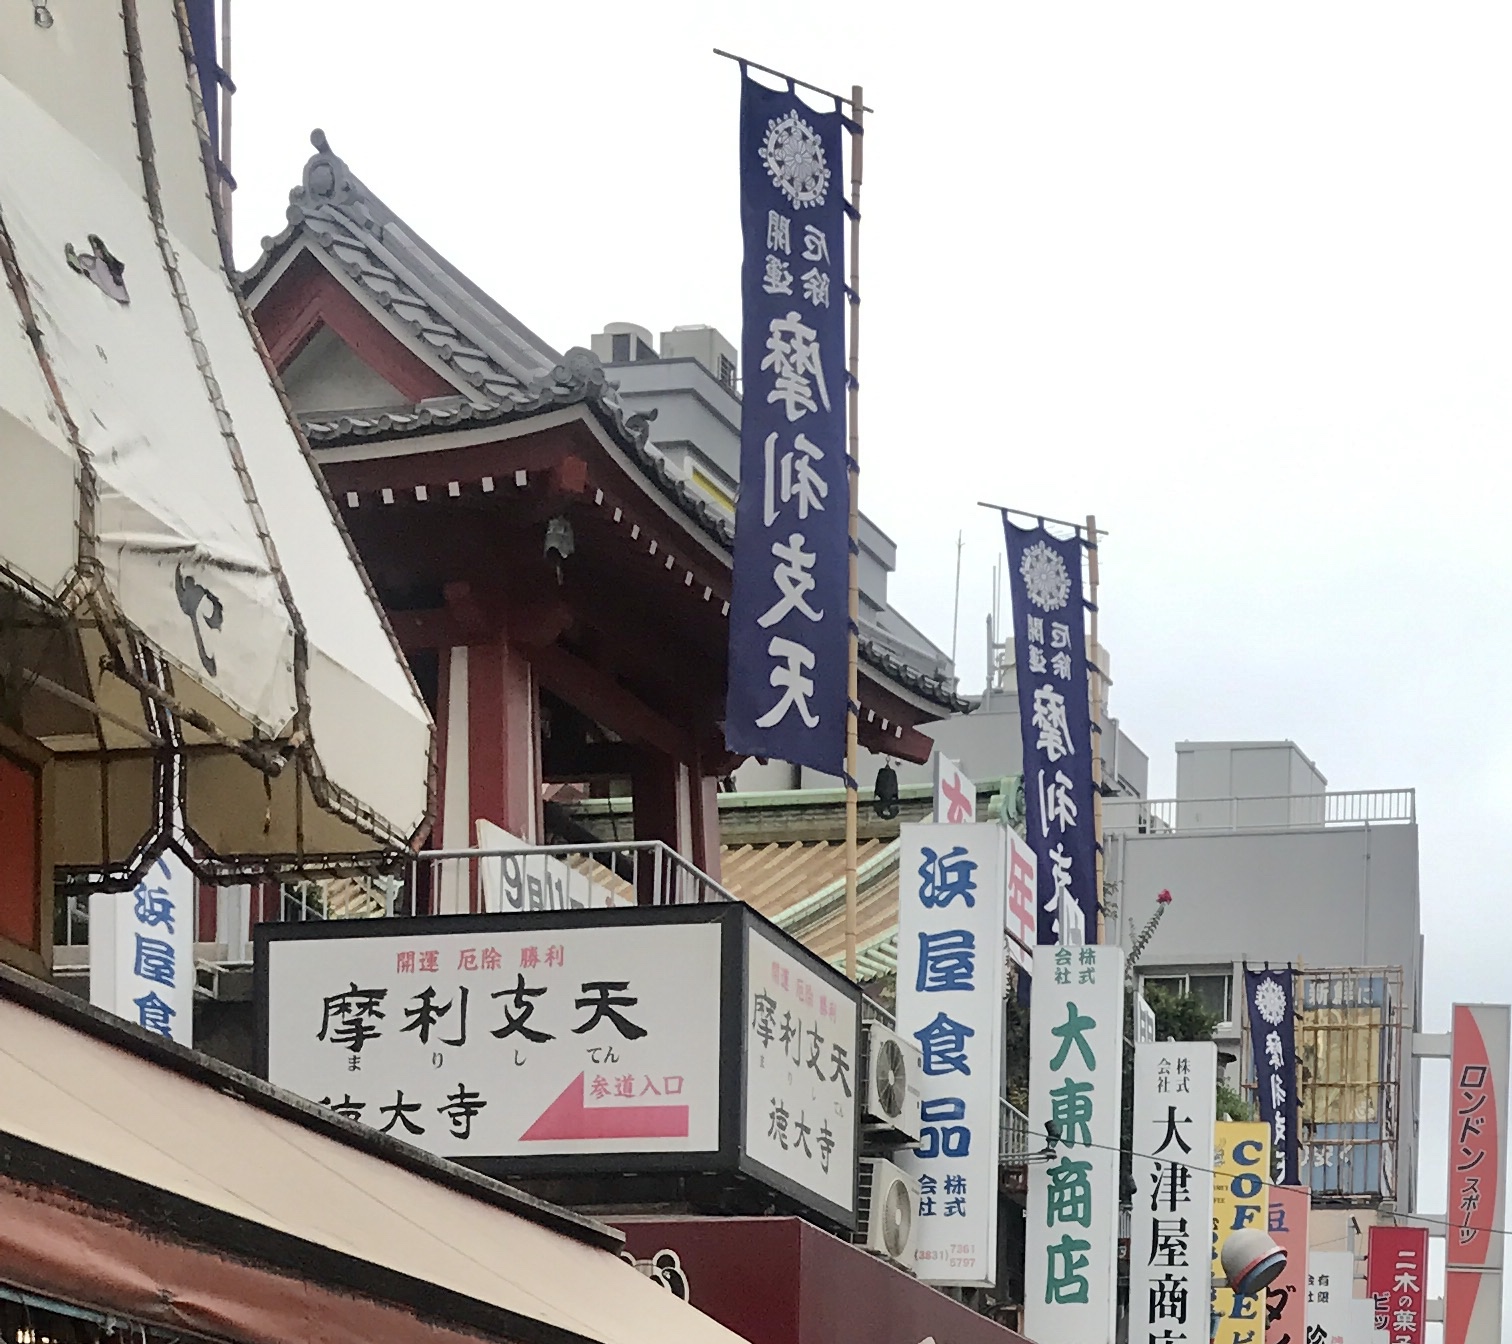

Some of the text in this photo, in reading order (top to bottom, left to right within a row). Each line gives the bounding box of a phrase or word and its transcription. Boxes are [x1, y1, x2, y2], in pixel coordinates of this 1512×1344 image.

[396, 945, 565, 974] 開運 厄除 勝利
[1053, 947, 1073, 985] 会社
[1078, 947, 1096, 985] 株式
[317, 972, 649, 1050] 摩利支天
[913, 845, 979, 1159] 浜屋食品
[587, 1048, 619, 1064] てん
[752, 987, 852, 1098] 摩利支天
[591, 1073, 685, 1098] 参道入口
[1156, 1057, 1172, 1095] 会社
[1174, 1057, 1191, 1095] 株式
[1455, 1065, 1487, 1172] ロンドン
[1044, 1003, 1097, 1307] 大東商店
[944, 1174, 967, 1218] 株式
[1458, 1176, 1481, 1247] スポーツ
[1229, 1140, 1264, 1321] COFE
